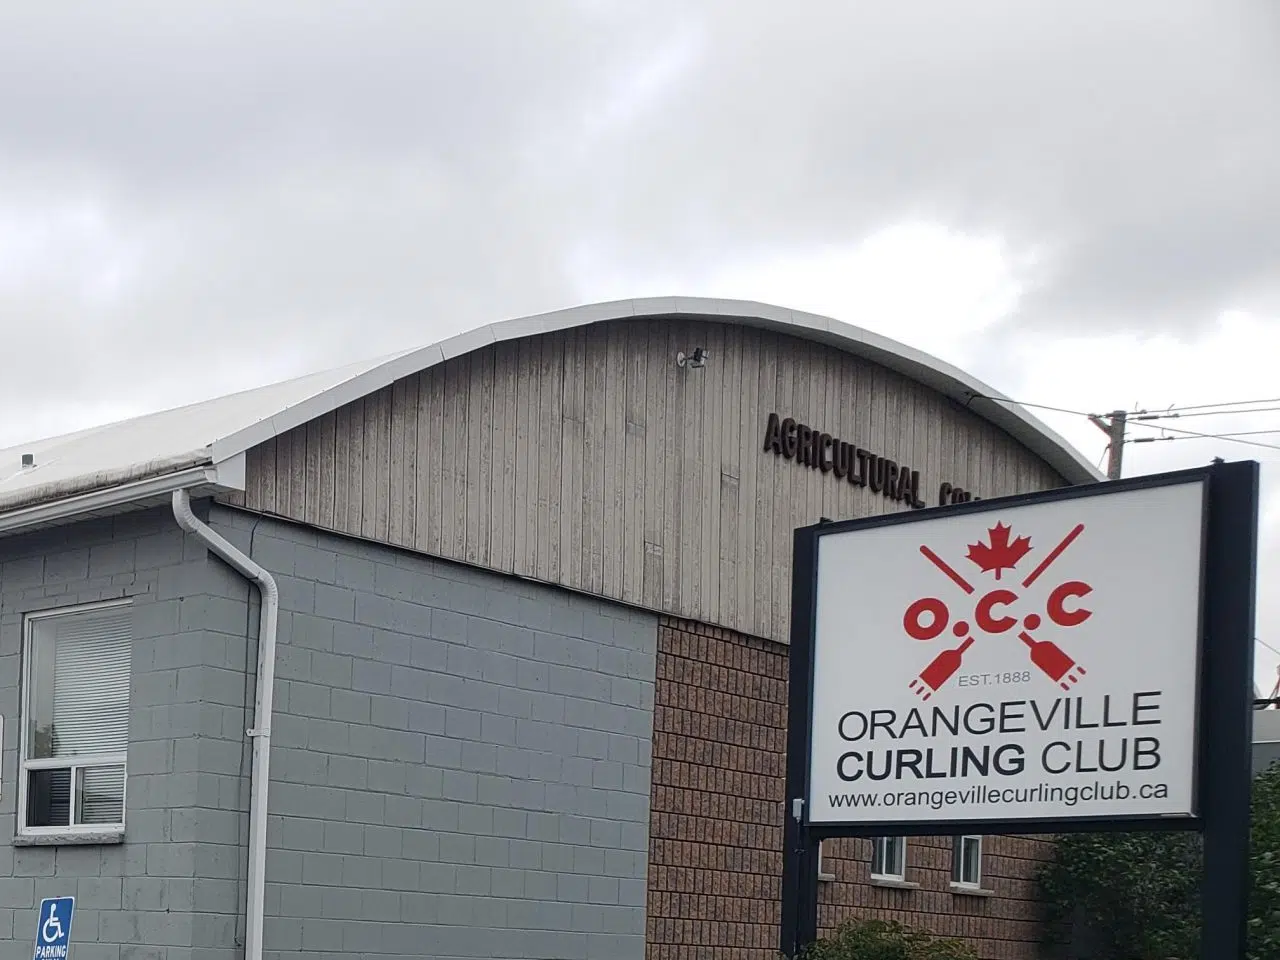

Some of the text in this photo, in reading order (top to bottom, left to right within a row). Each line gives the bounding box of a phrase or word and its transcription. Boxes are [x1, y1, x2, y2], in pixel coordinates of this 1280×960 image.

[764, 412, 925, 509] AGRICULTURAL
[958, 671, 1031, 687] EST.1888
[837, 690, 1162, 741] ORANGEVILLE
[836, 736, 1162, 782] CURLING CLUB
[828, 780, 1169, 810] www.orangevillecurlingclub.ca
[35, 945, 67, 958] PARKING
